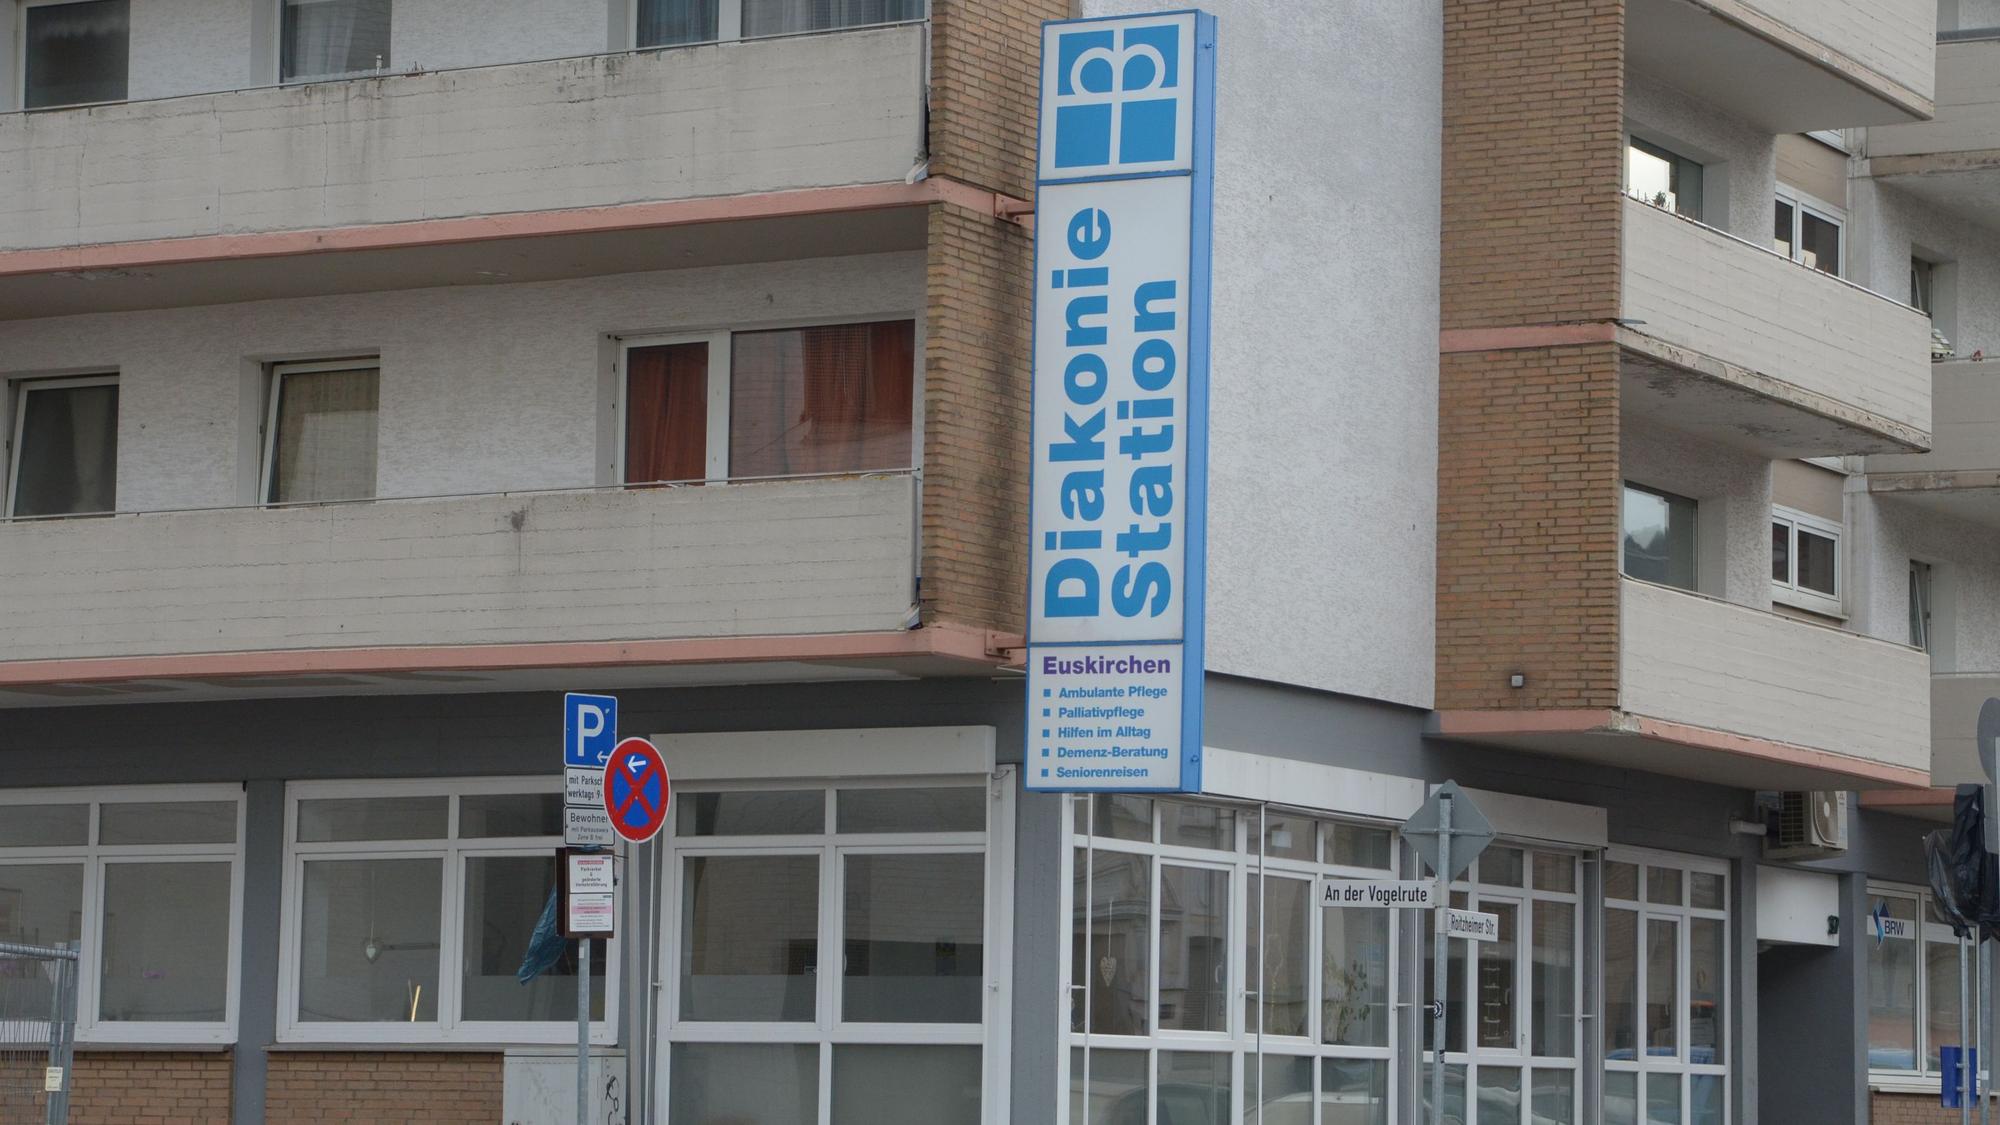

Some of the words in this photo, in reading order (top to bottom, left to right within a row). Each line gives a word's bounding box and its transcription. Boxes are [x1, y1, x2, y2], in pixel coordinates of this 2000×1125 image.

[1044, 207, 1111, 618] Diakonie
[1111, 279, 1176, 618] Station
[1043, 655, 1171, 674] Euskirchen
[1058, 687, 1125, 698] Ambulante
[1128, 686, 1168, 699] Pflege
[1058, 706, 1145, 719] Palliativpflege
[577, 703, 605, 757] P
[1058, 727, 1093, 738] Hilfen
[1097, 727, 1112, 738] im
[1116, 726, 1151, 739] Alltag
[1057, 746, 1168, 759] Demenz-Beratung
[1056, 766, 1148, 778] Seniorenreisen
[569, 775, 579, 785] mit
[568, 789, 594, 800] werktags
[1324, 884, 1340, 901] An
[1344, 884, 1364, 901] der
[1368, 884, 1428, 906] Vogelrute
[1485, 918, 1496, 935] Str.
[1884, 920, 1905, 936] BRW
